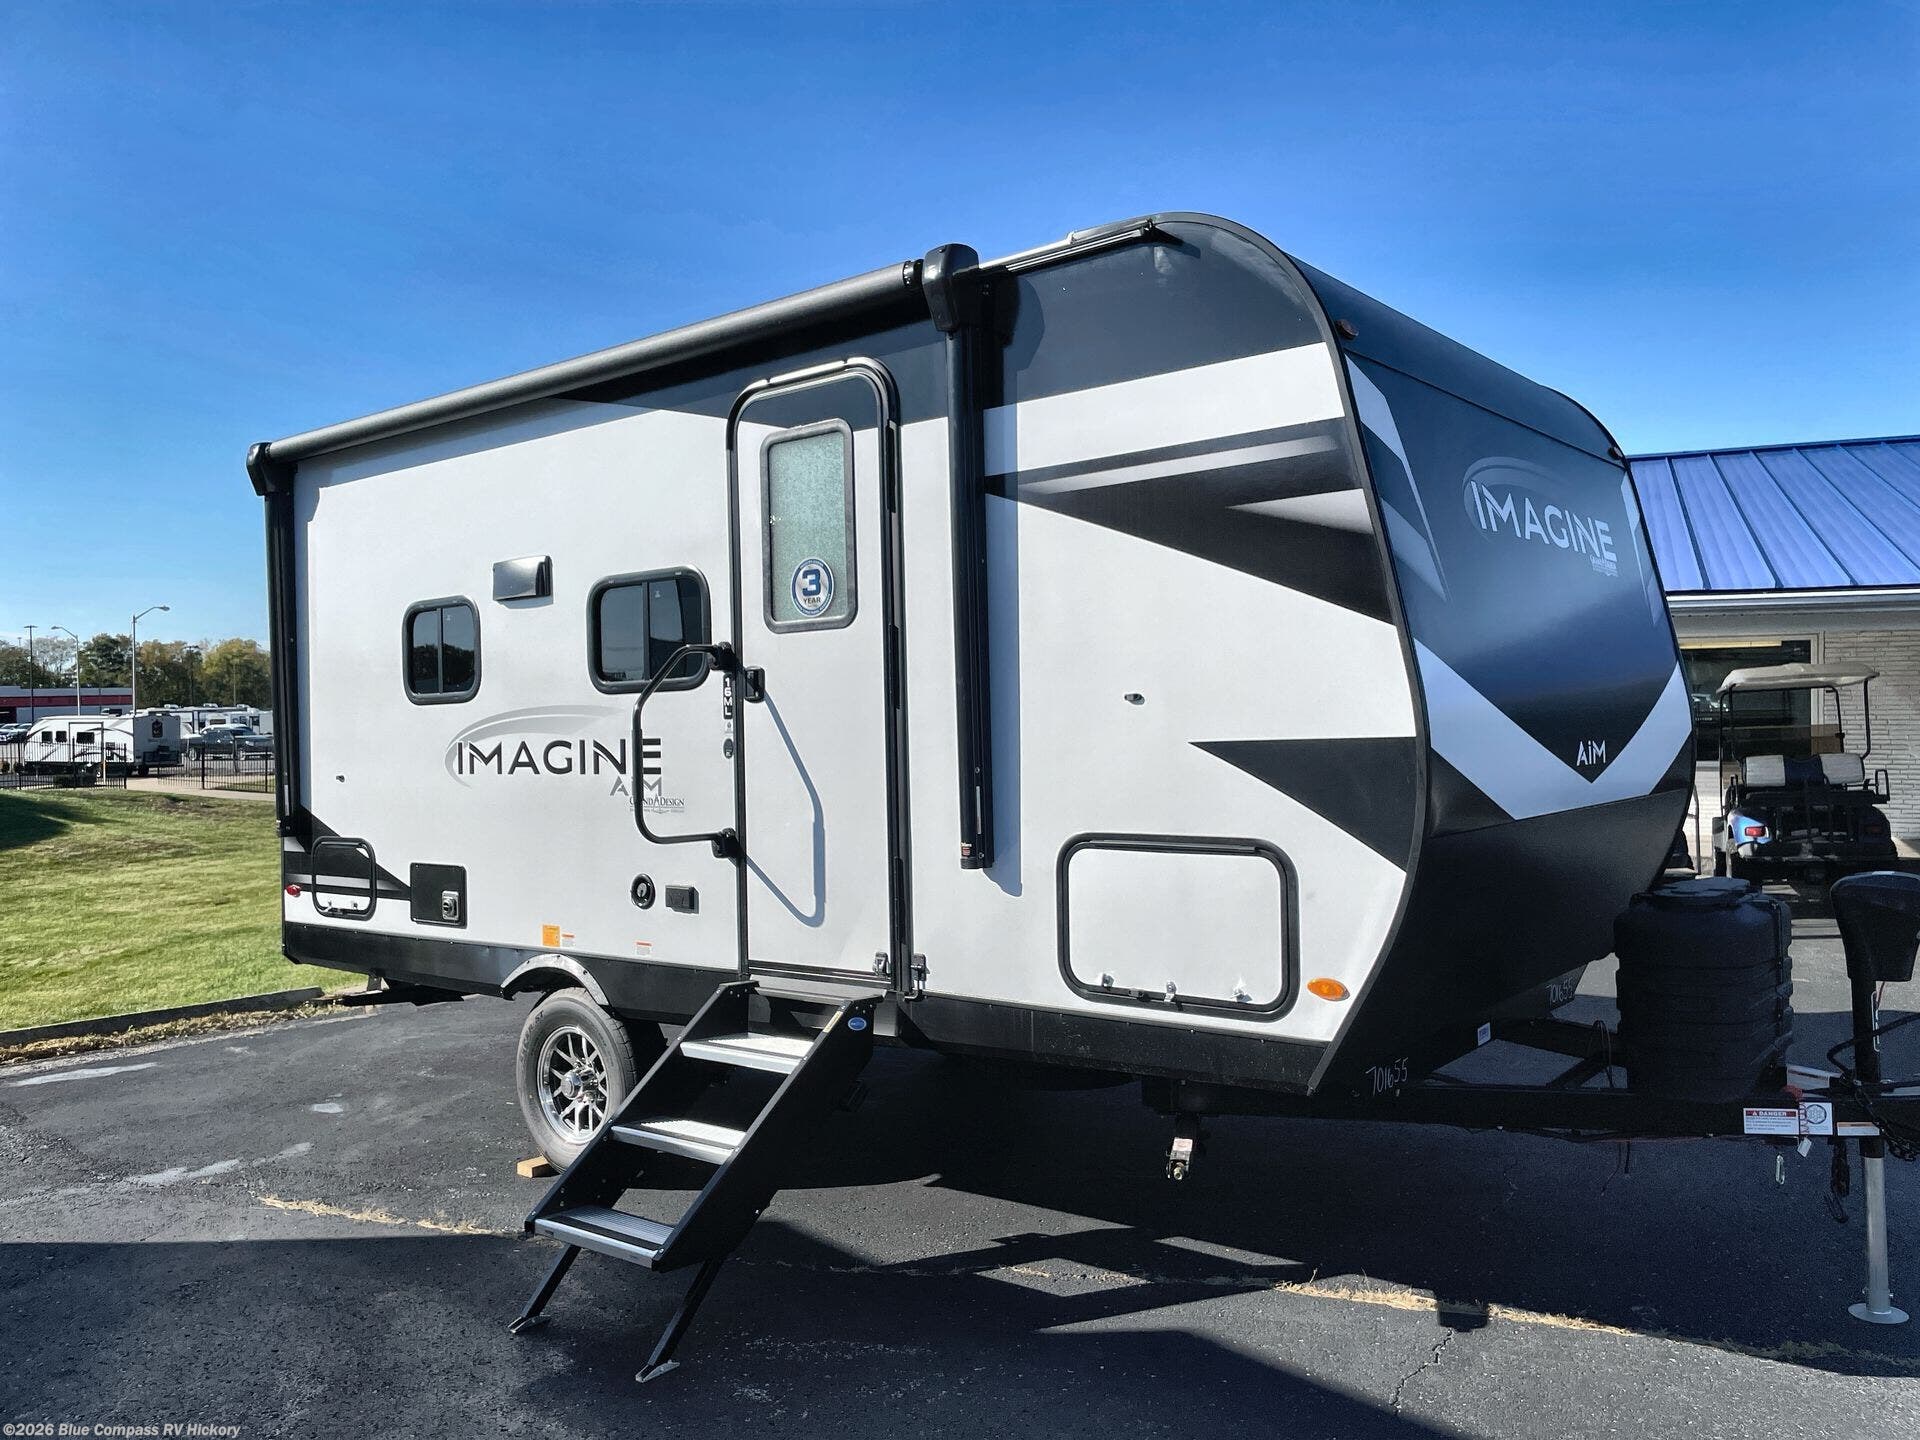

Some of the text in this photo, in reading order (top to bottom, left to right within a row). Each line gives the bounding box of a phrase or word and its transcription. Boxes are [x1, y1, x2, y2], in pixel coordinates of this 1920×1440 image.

[1470, 480, 1618, 562] IMAGINE
[802, 569, 821, 597] 3
[457, 738, 661, 775] IMAGINE
[609, 776, 662, 796] AM
